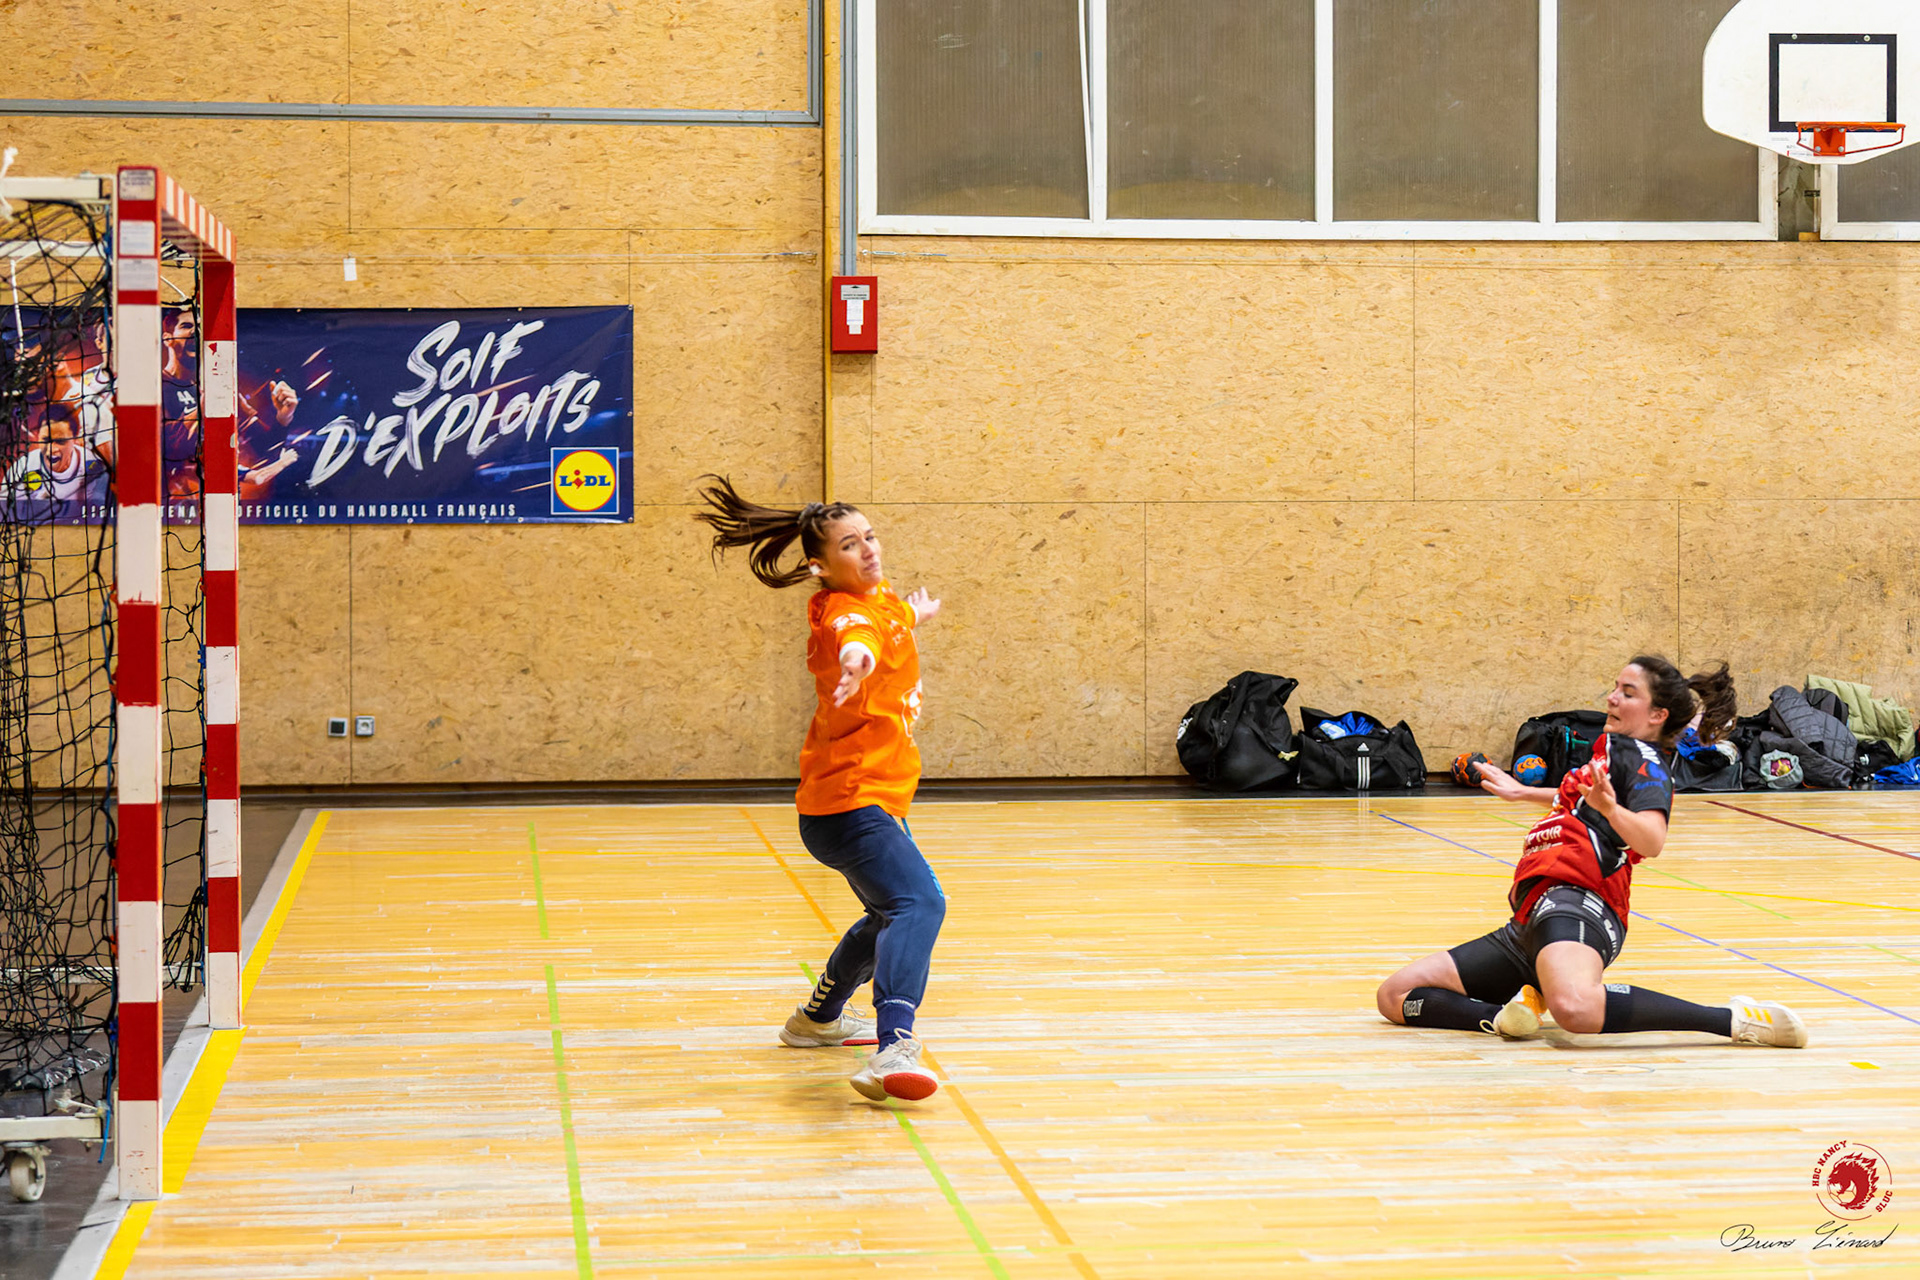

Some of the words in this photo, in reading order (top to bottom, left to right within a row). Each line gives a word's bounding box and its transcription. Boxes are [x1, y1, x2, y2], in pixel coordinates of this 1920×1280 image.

[318, 504, 337, 518] DU
[347, 504, 427, 518] HANDBALL
[437, 504, 516, 520] FRANÇAIS
